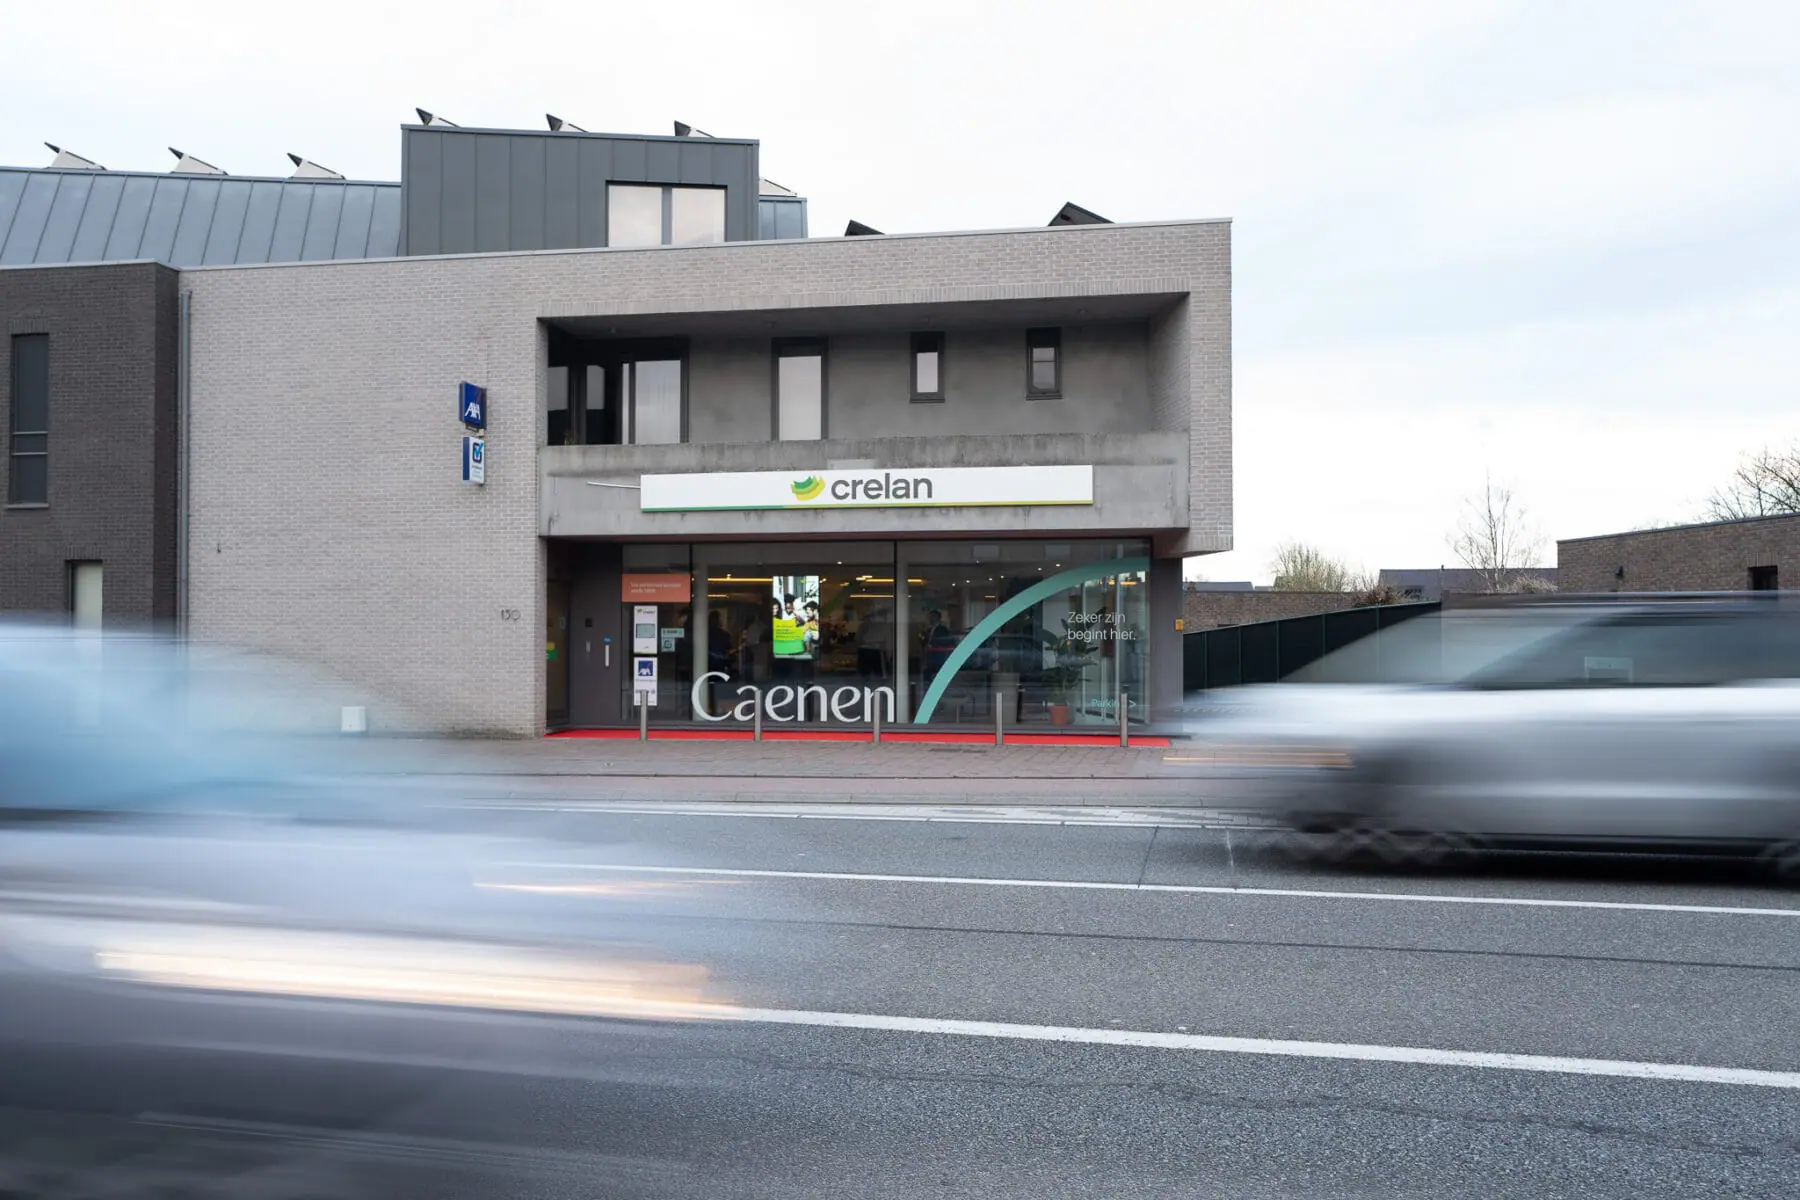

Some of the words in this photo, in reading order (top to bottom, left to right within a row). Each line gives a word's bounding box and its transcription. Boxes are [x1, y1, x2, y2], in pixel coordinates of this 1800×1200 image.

[464, 402, 481, 420] AXA
[831, 472, 933, 501] crelan
[1068, 611, 1104, 624] Zeker
[1105, 611, 1126, 626] zijn
[1067, 628, 1107, 642] begint
[1110, 627, 1136, 641] hier.
[691, 670, 895, 723] Caenen
